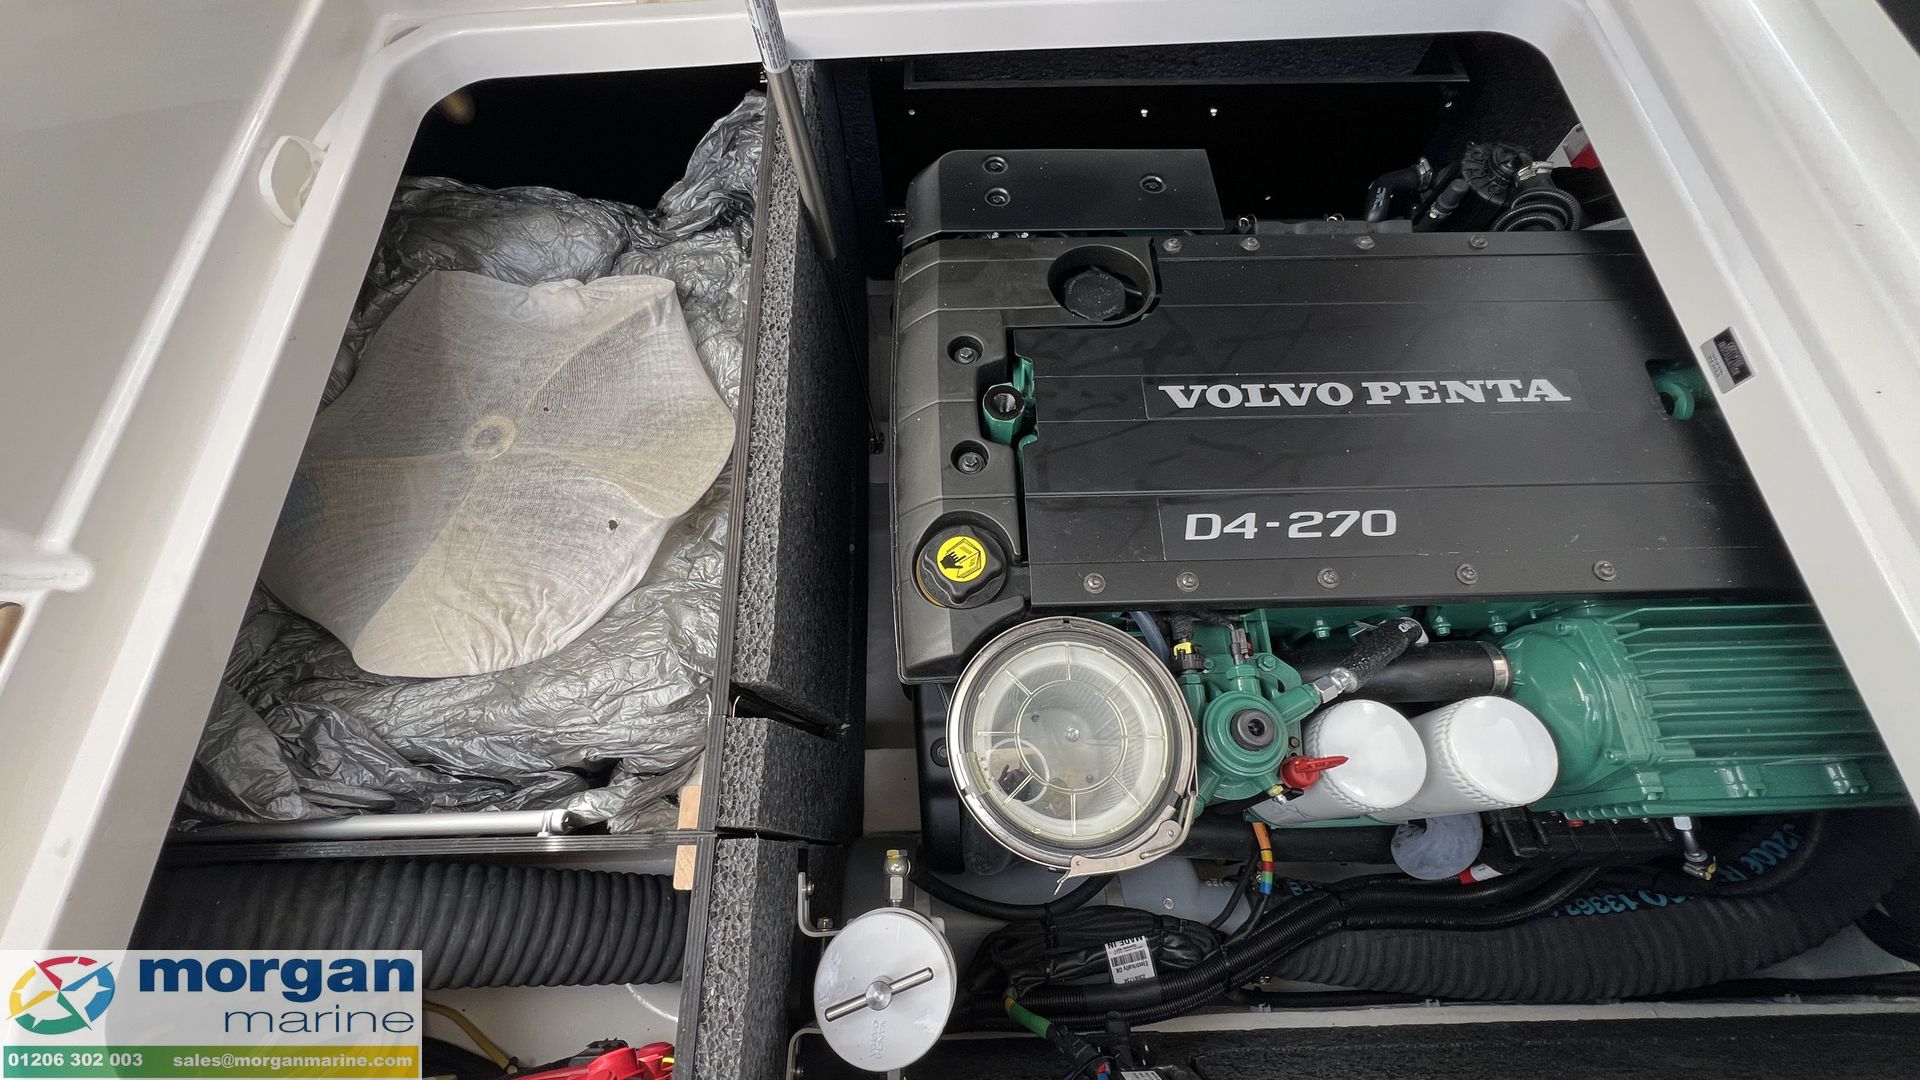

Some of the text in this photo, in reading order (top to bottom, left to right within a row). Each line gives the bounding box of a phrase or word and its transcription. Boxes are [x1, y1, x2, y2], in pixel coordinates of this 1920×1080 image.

[1158, 379, 1571, 409] VOLVO PENTA
[1184, 509, 1397, 541] D4-270
